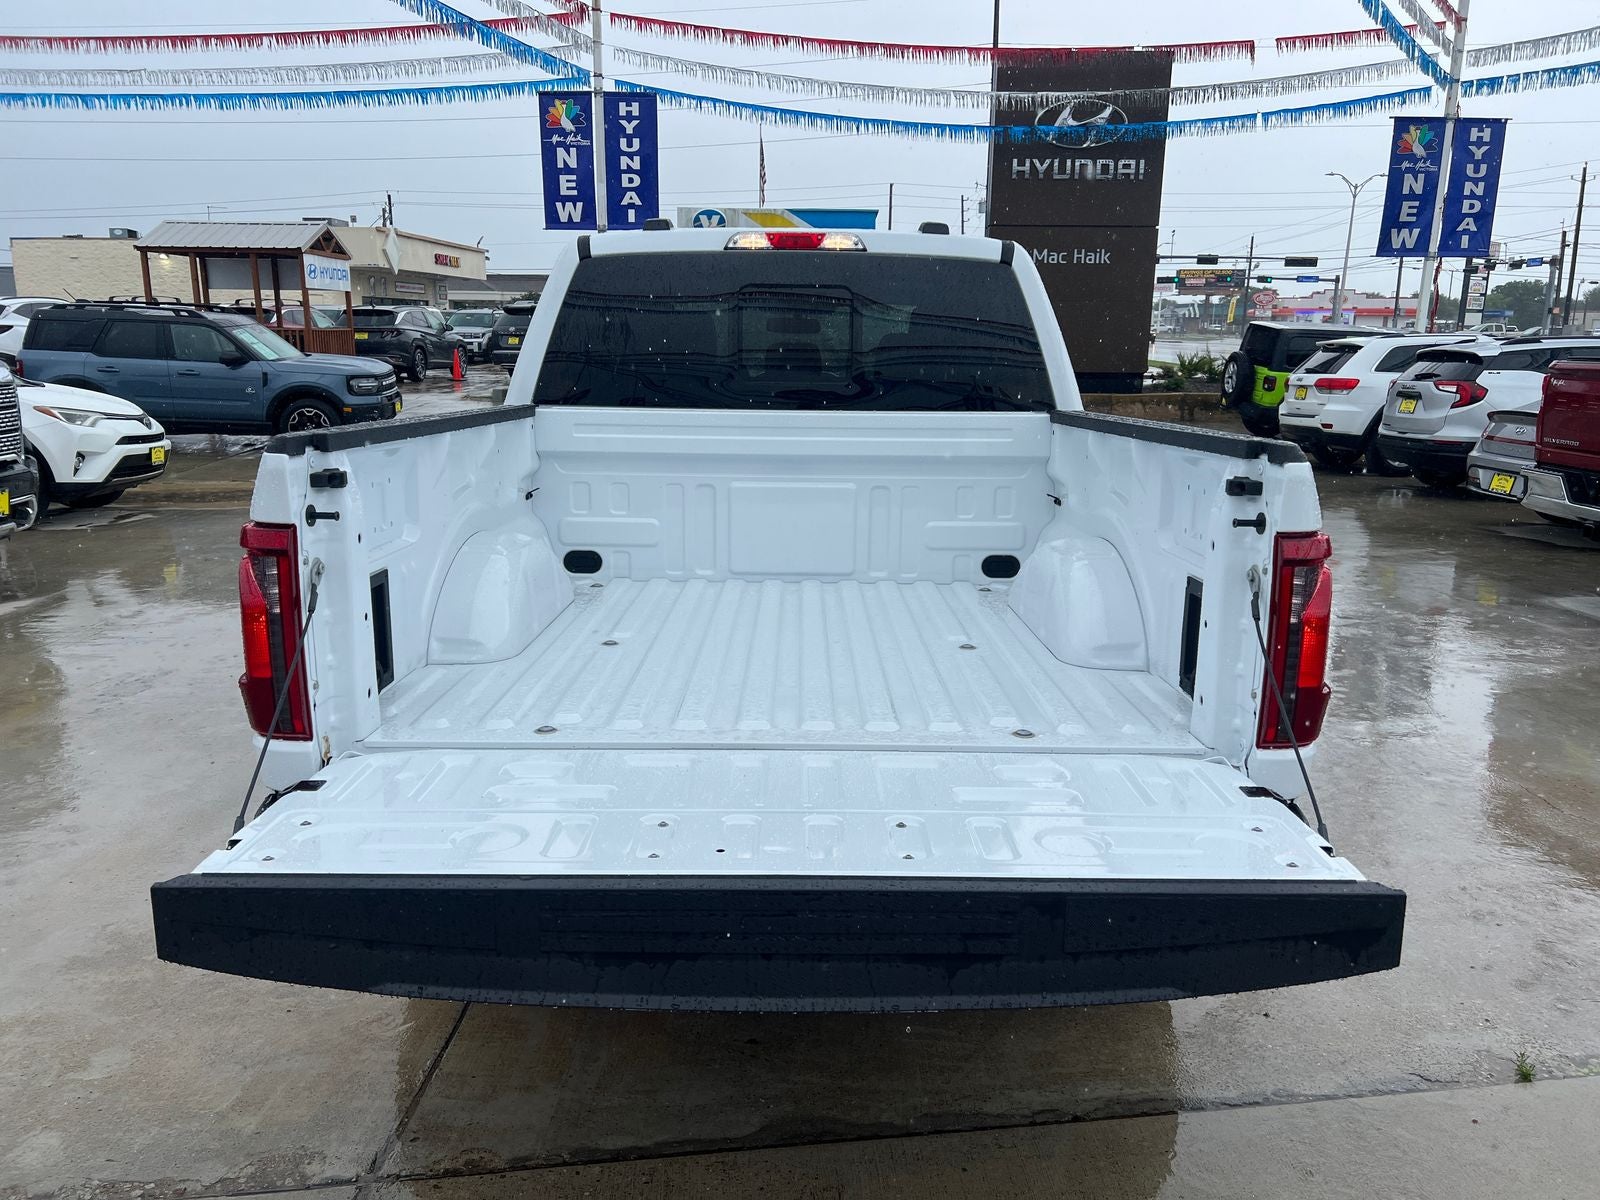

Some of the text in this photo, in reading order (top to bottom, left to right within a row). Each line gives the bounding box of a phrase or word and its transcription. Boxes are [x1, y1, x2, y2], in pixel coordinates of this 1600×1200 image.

[555, 147, 584, 223] NEW
[618, 102, 643, 223] HYUNDAI
[1011, 158, 1146, 181] HYUNDAI
[1456, 127, 1492, 249] HYUNDAI
[1390, 173, 1425, 249] NEW
[319, 266, 349, 281] HYUNDAI
[1032, 248, 1111, 264] Mac Haik
